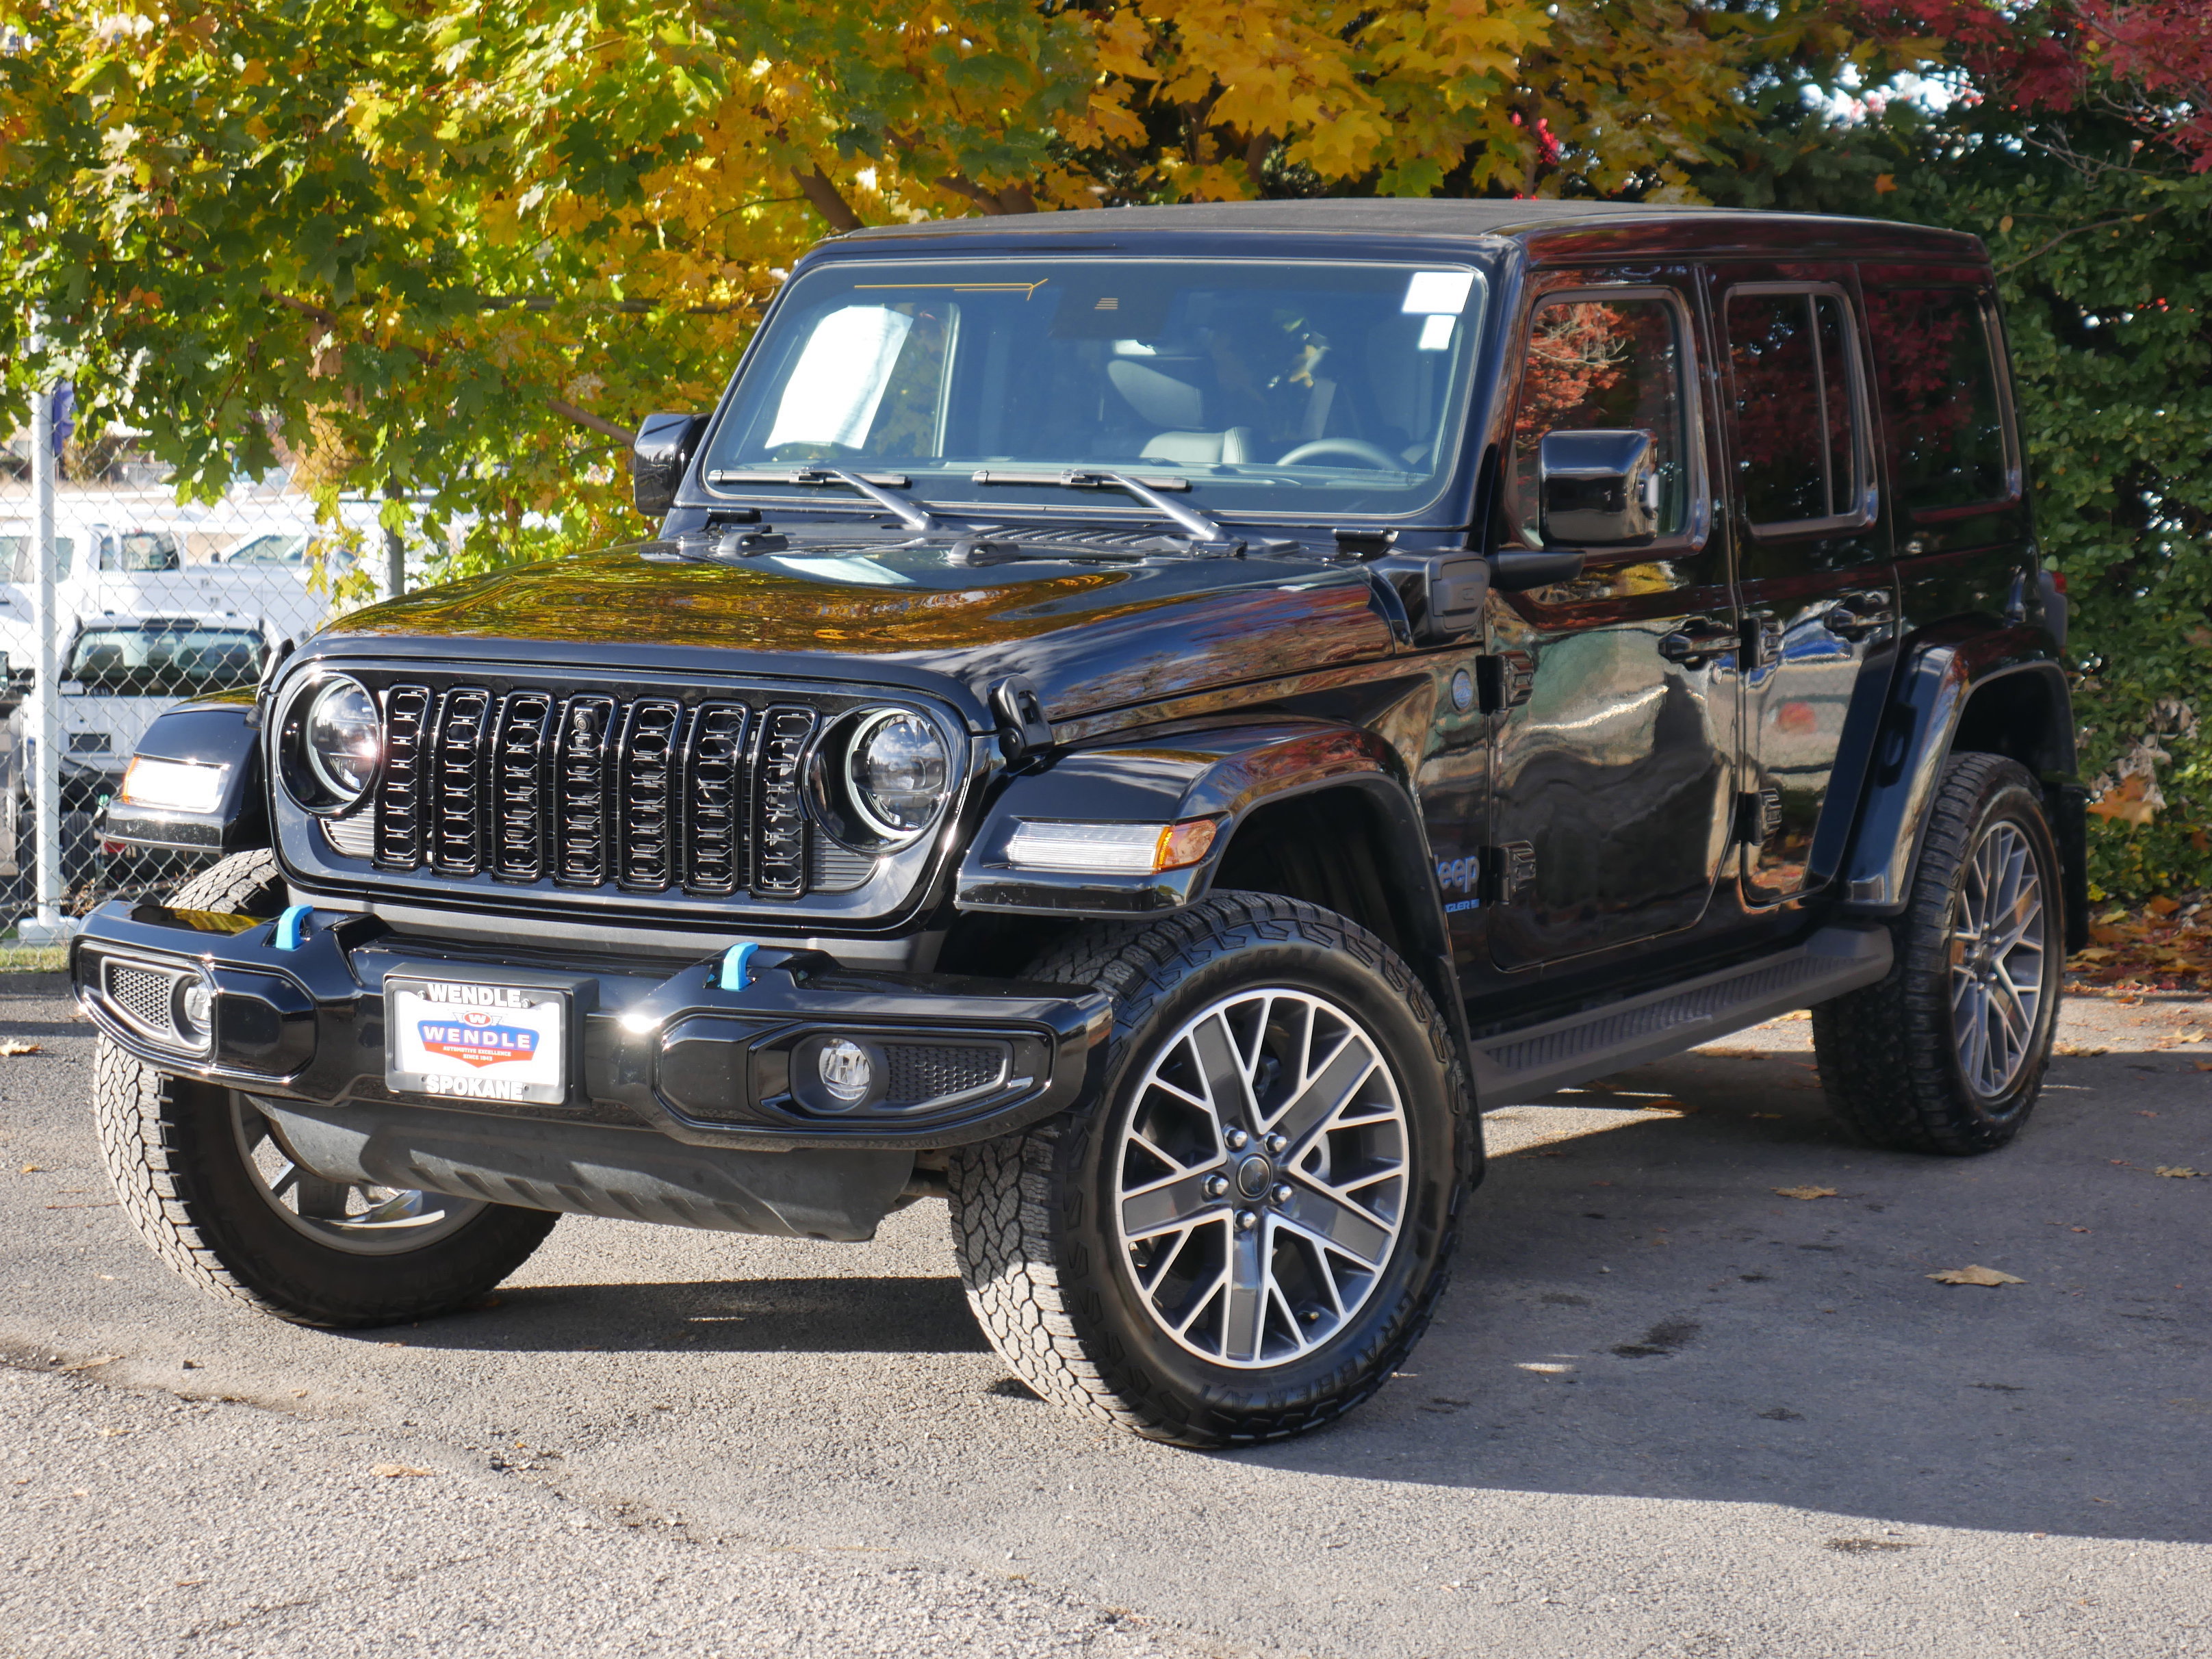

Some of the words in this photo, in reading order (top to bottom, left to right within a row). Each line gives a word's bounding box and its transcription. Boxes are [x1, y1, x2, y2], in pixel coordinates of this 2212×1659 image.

[427, 983, 522, 1007] WENDLE
[468, 1014, 487, 1025] W
[423, 1025, 530, 1049] WENDLE
[443, 1046, 477, 1054] AUTOMOTIVE
[478, 1049, 511, 1057] EXCELLENCE
[426, 1075, 524, 1101] SPOKANE
[1266, 1290, 1417, 1410] GRABBER
